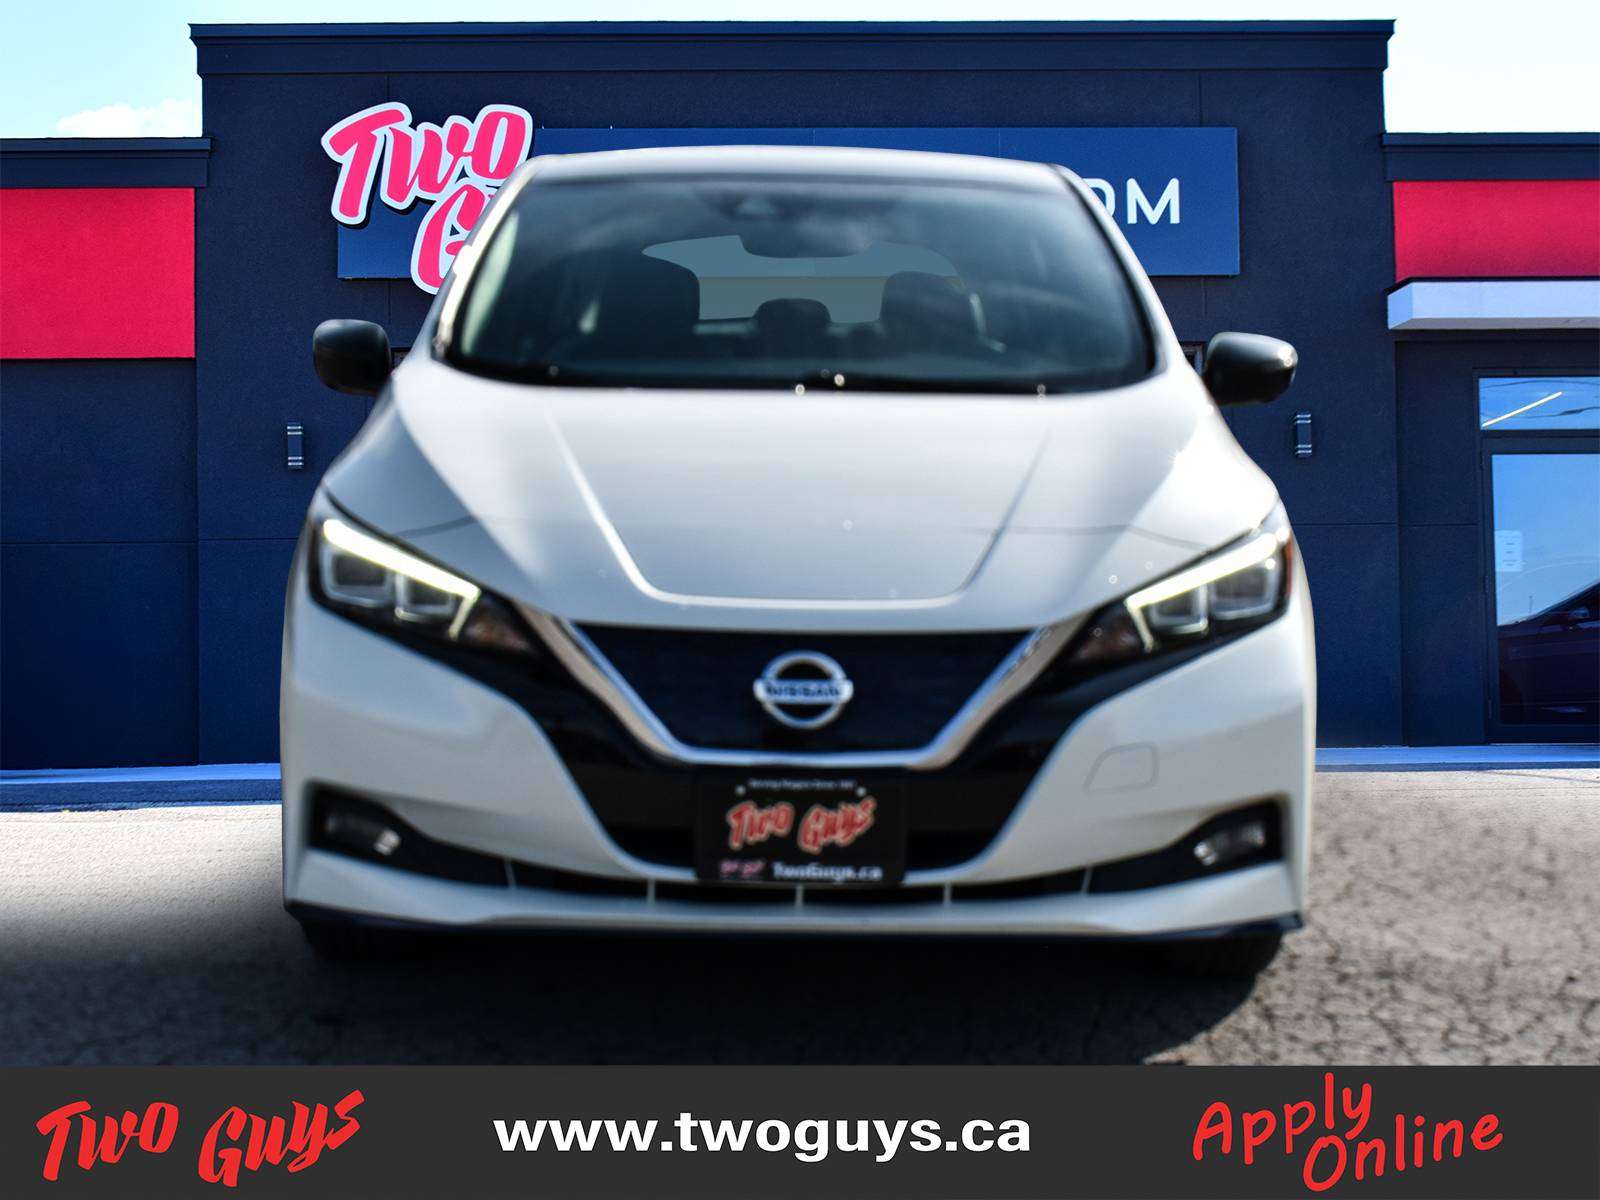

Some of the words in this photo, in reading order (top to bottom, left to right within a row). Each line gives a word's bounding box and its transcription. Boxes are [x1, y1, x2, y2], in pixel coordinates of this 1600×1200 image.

[325, 105, 529, 220] Two
[726, 801, 795, 849] Two
[798, 797, 877, 853] Guys
